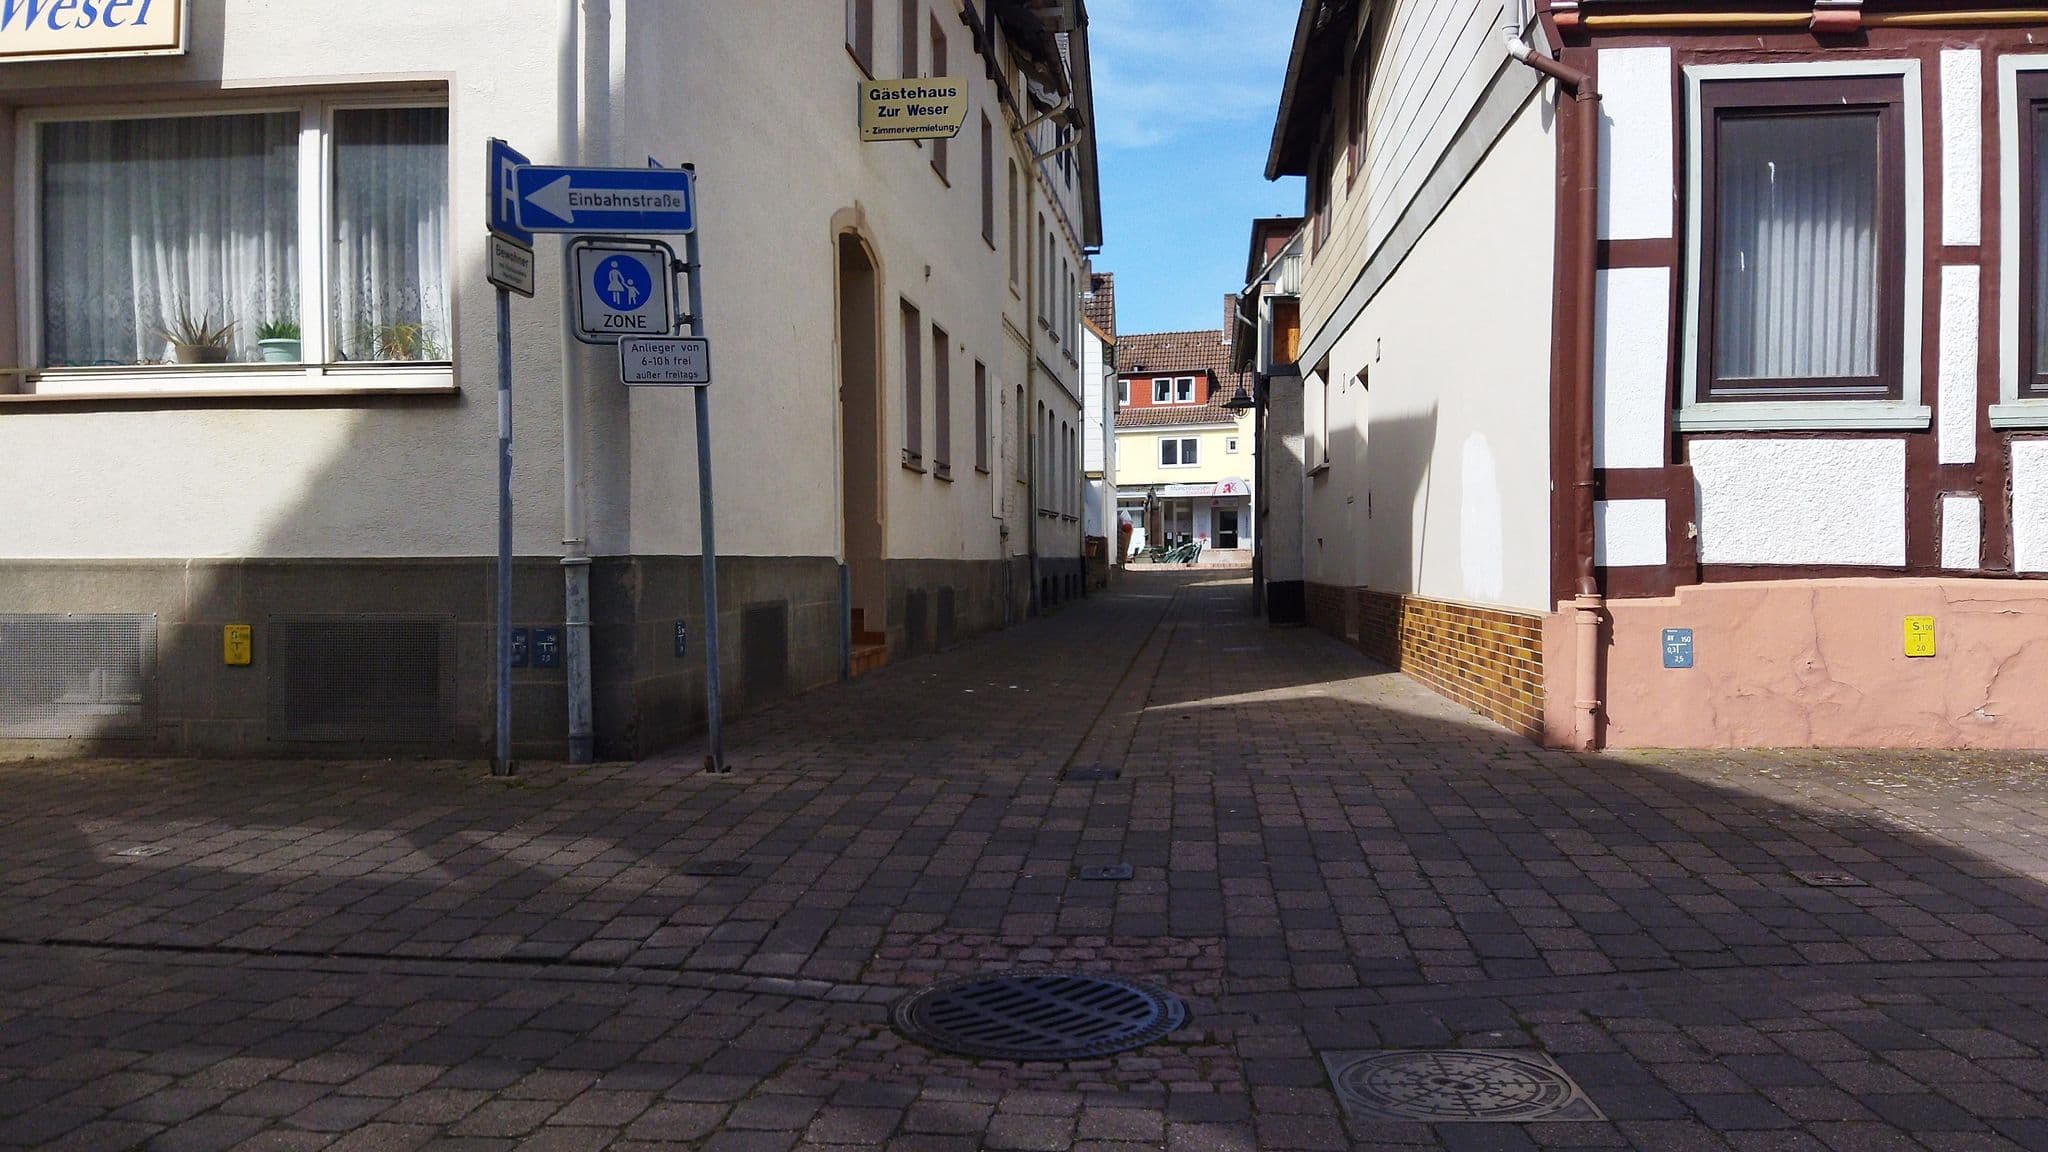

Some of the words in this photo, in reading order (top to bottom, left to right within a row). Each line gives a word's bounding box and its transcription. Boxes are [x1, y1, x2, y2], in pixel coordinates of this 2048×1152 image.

[869, 86, 957, 100] Gästehaus
[878, 106, 901, 118] Zur
[907, 104, 949, 117] Weser
[568, 192, 681, 208] Einbahnstraße
[603, 314, 647, 329] ZONE
[631, 343, 676, 354] Anlieger
[681, 344, 700, 352] von
[674, 356, 692, 365] frei
[636, 371, 661, 380] außer
[665, 371, 699, 380] freitags
[1912, 621, 1920, 631] S
